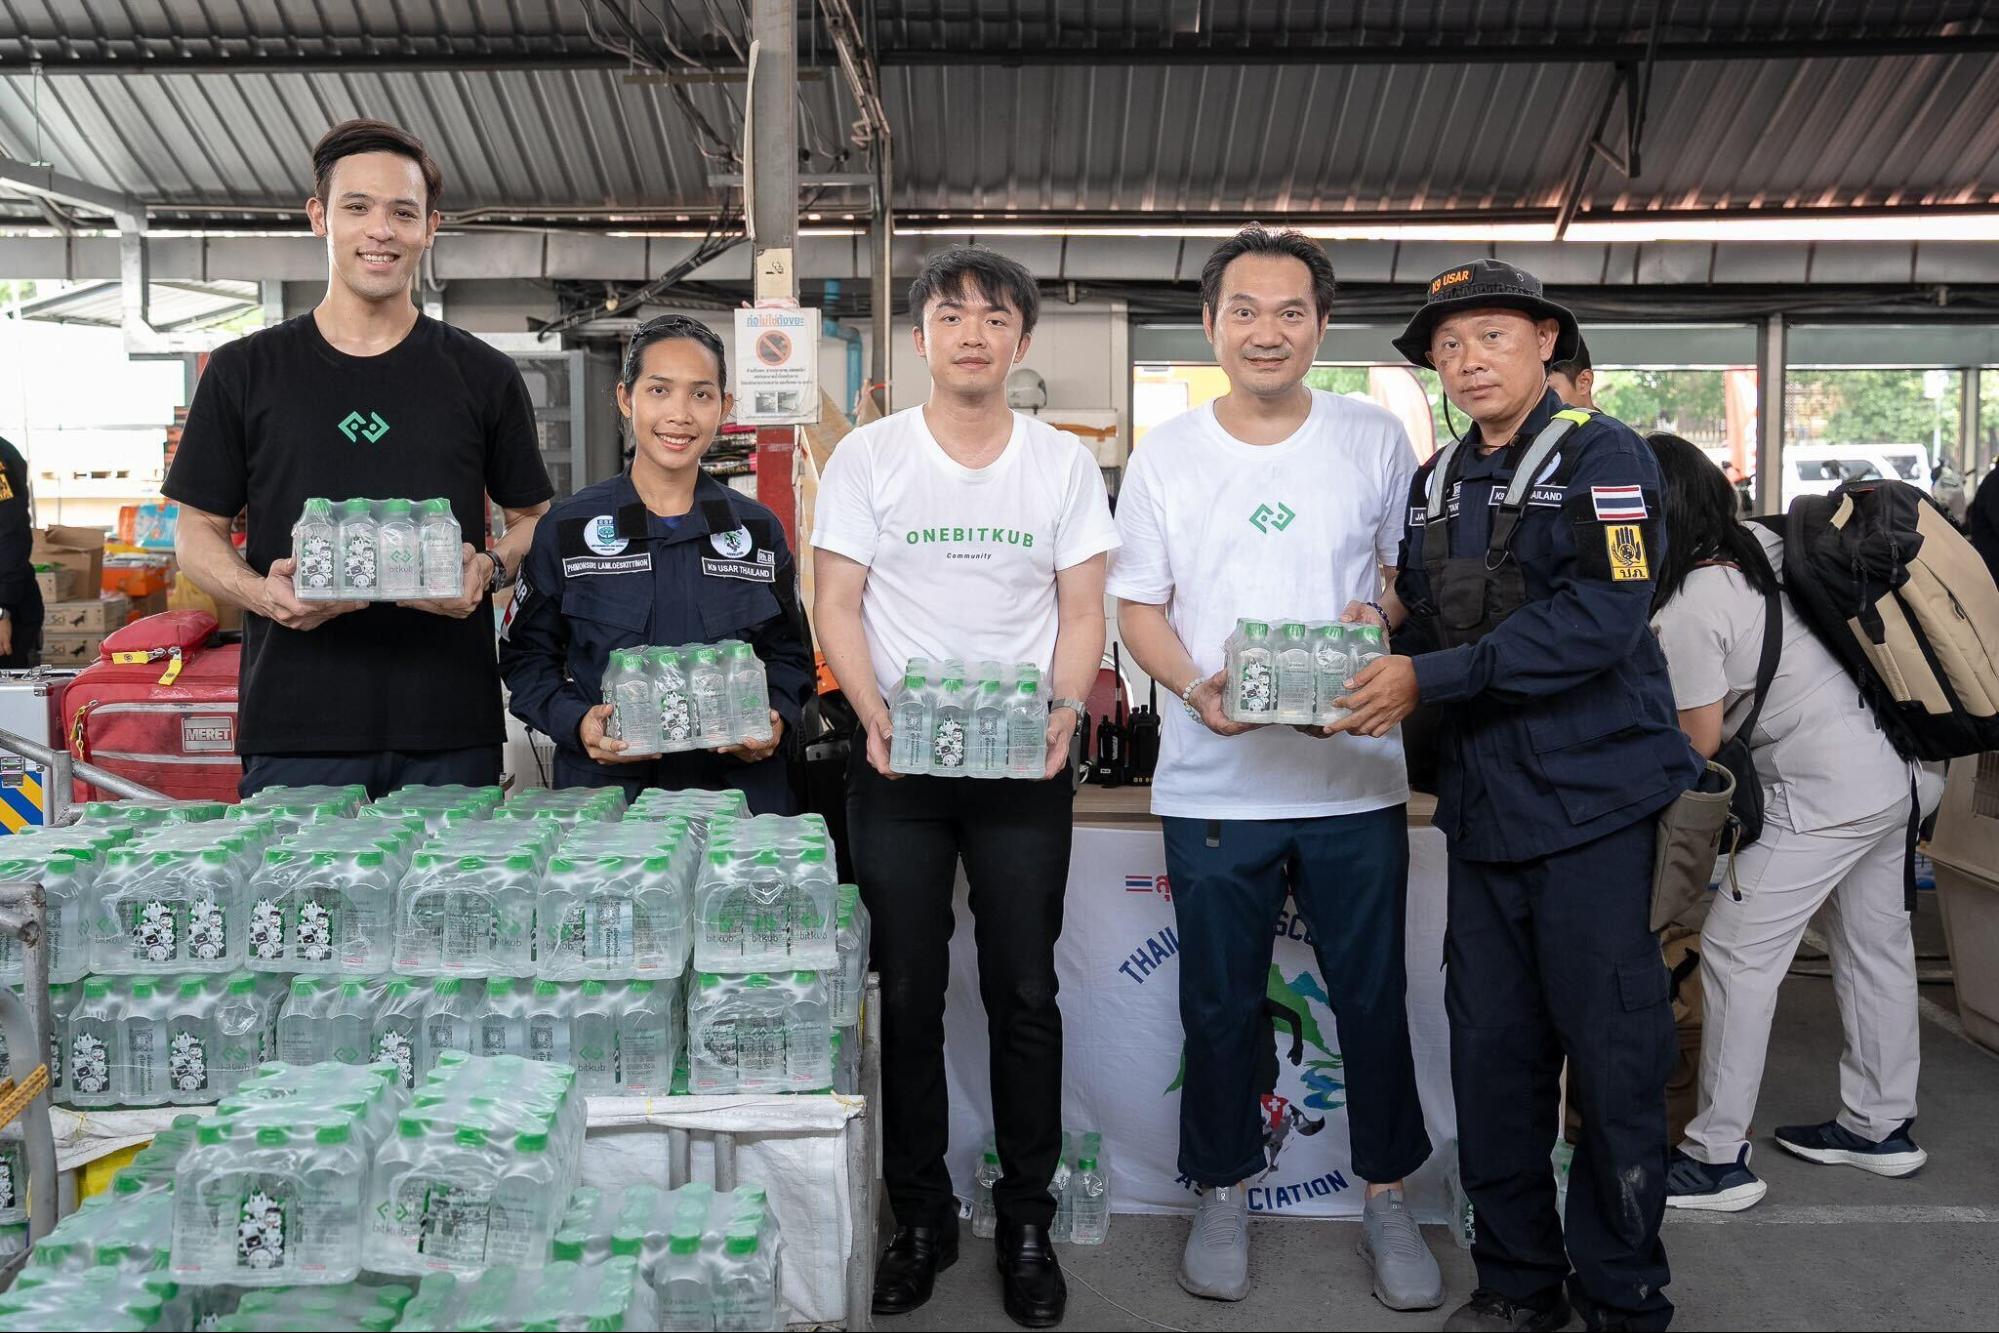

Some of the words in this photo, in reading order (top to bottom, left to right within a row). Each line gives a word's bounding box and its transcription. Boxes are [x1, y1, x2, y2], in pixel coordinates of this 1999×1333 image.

[1443, 270, 1469, 286] USAR
[1494, 492, 1505, 500] K9
[1530, 491, 1563, 501] AILAND
[906, 527, 1034, 547] ONEBITKUB
[946, 552, 992, 560] Community
[718, 565, 738, 573] USAR
[739, 566, 769, 578] THAILAND
[185, 728, 231, 741] MERET
[1118, 926, 1180, 985] THAIL
